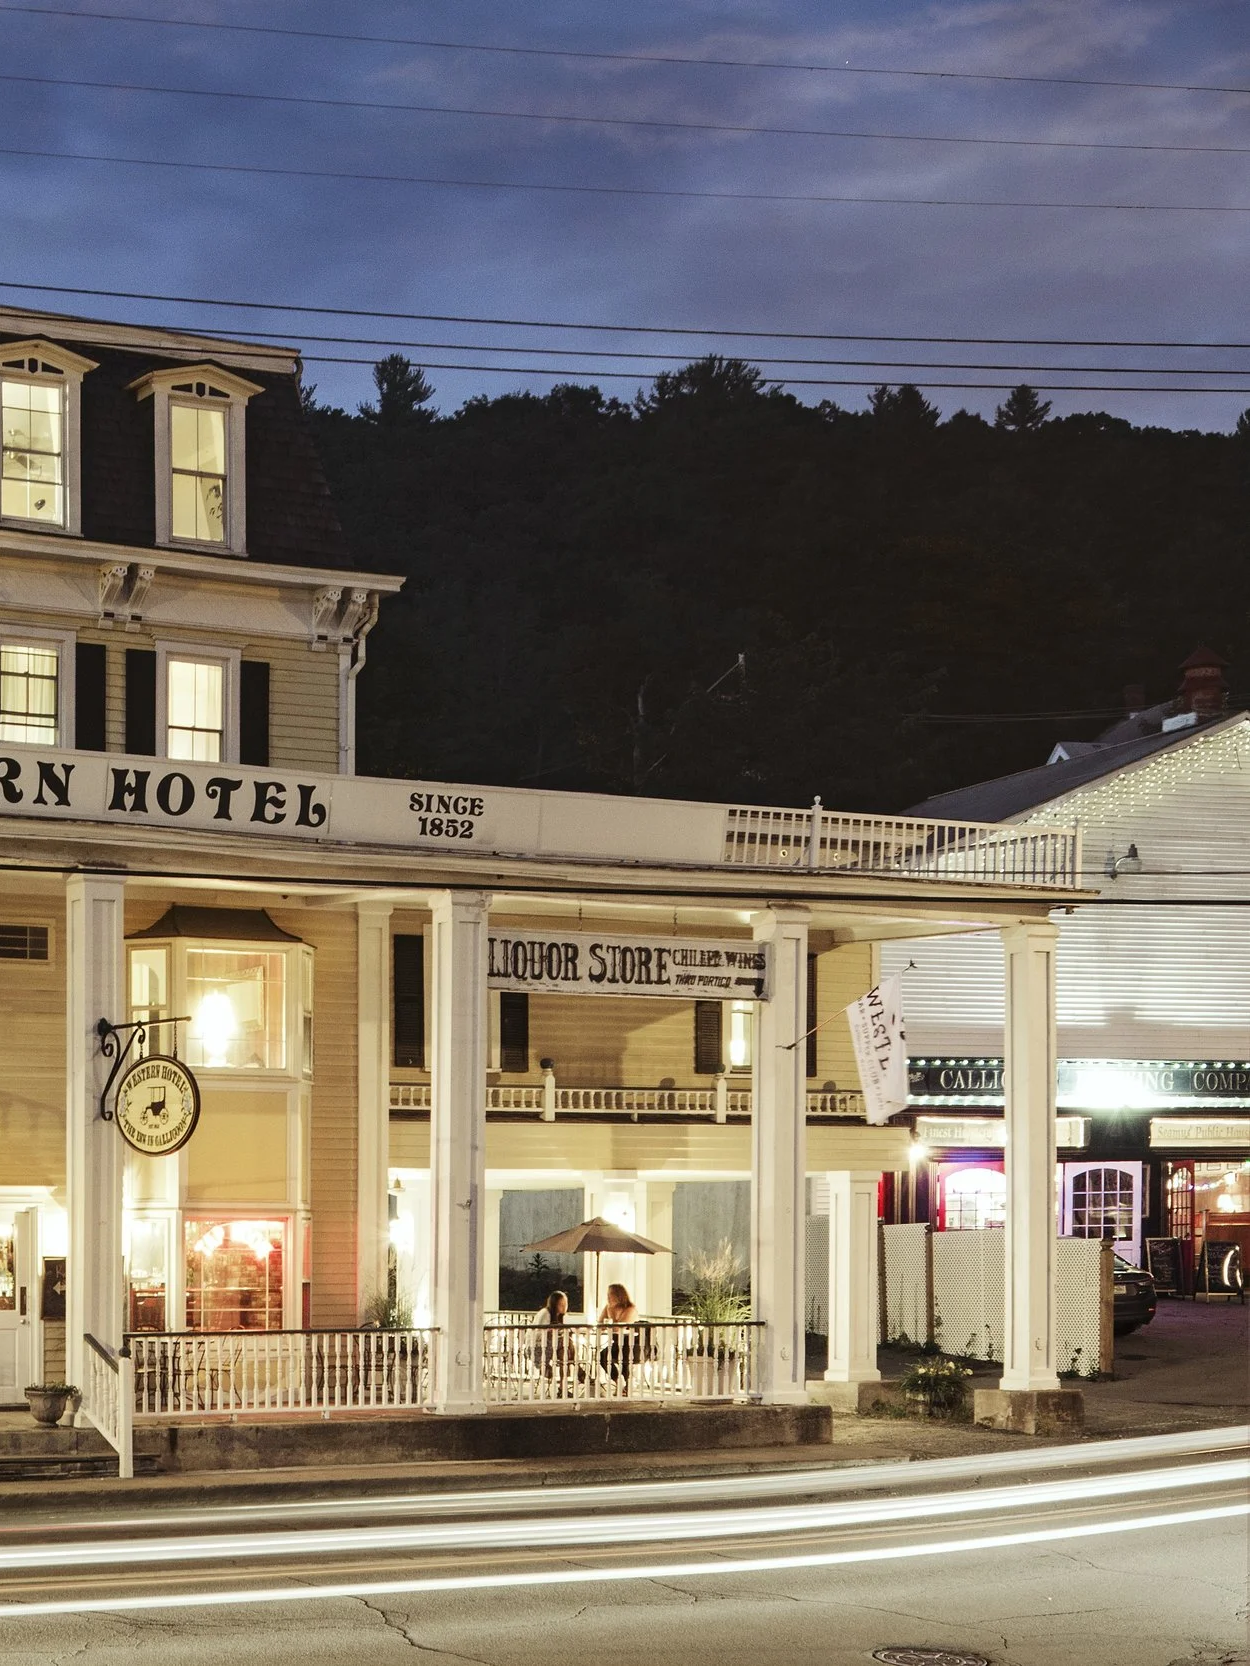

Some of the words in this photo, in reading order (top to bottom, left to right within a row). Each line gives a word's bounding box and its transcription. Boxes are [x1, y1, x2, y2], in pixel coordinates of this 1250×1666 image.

[108, 767, 327, 828] HOTEL
[409, 792, 484, 816] SINCE
[418, 816, 474, 839] 1852
[487, 938, 581, 981] LIQUOR
[588, 943, 671, 985] STORE
[697, 975, 732, 988] PORTICO
[126, 1064, 161, 1090] WESTERN
[161, 1065, 186, 1094] HOTEL
[940, 1069, 1005, 1089] CALLI
